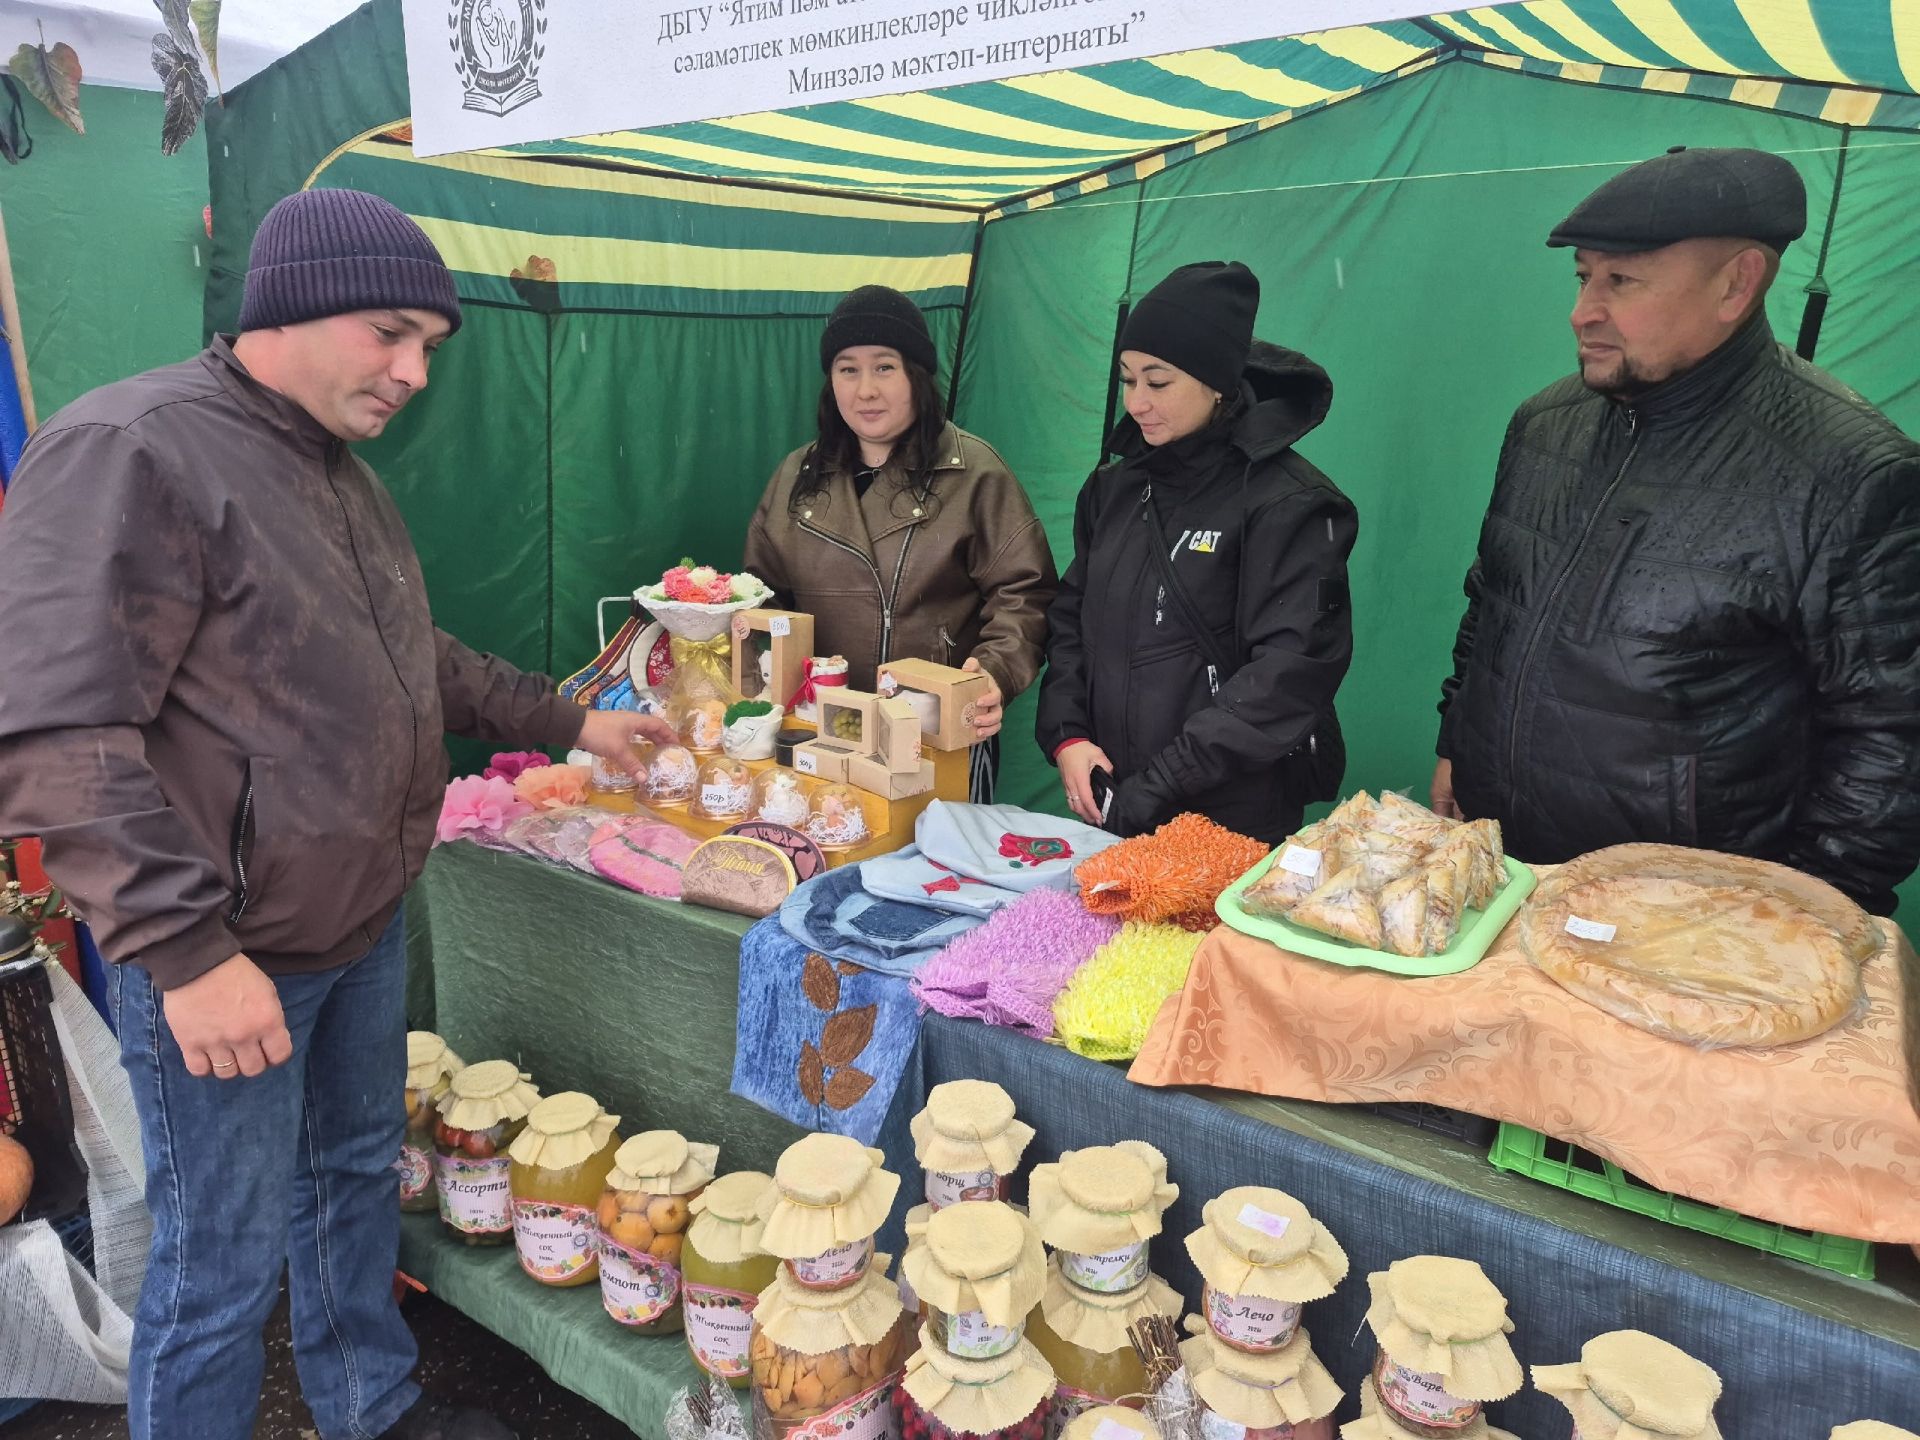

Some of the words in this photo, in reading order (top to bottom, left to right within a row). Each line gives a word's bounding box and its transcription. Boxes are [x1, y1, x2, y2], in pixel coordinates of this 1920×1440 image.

[657, 6, 713, 45] ДБГУ
[674, 39, 783, 73] сәламәтлек
[789, 5, 969, 55] мөмкинлекләре
[788, 61, 885, 94] Минзәлә
[891, 10, 1146, 79] мәктәп-интернаты”
[1188, 530, 1222, 553] CAT
[448, 1180, 508, 1197] Ассорти
[695, 1313, 751, 1331] Тыквенный
[1236, 1306, 1274, 1321] Лечо
